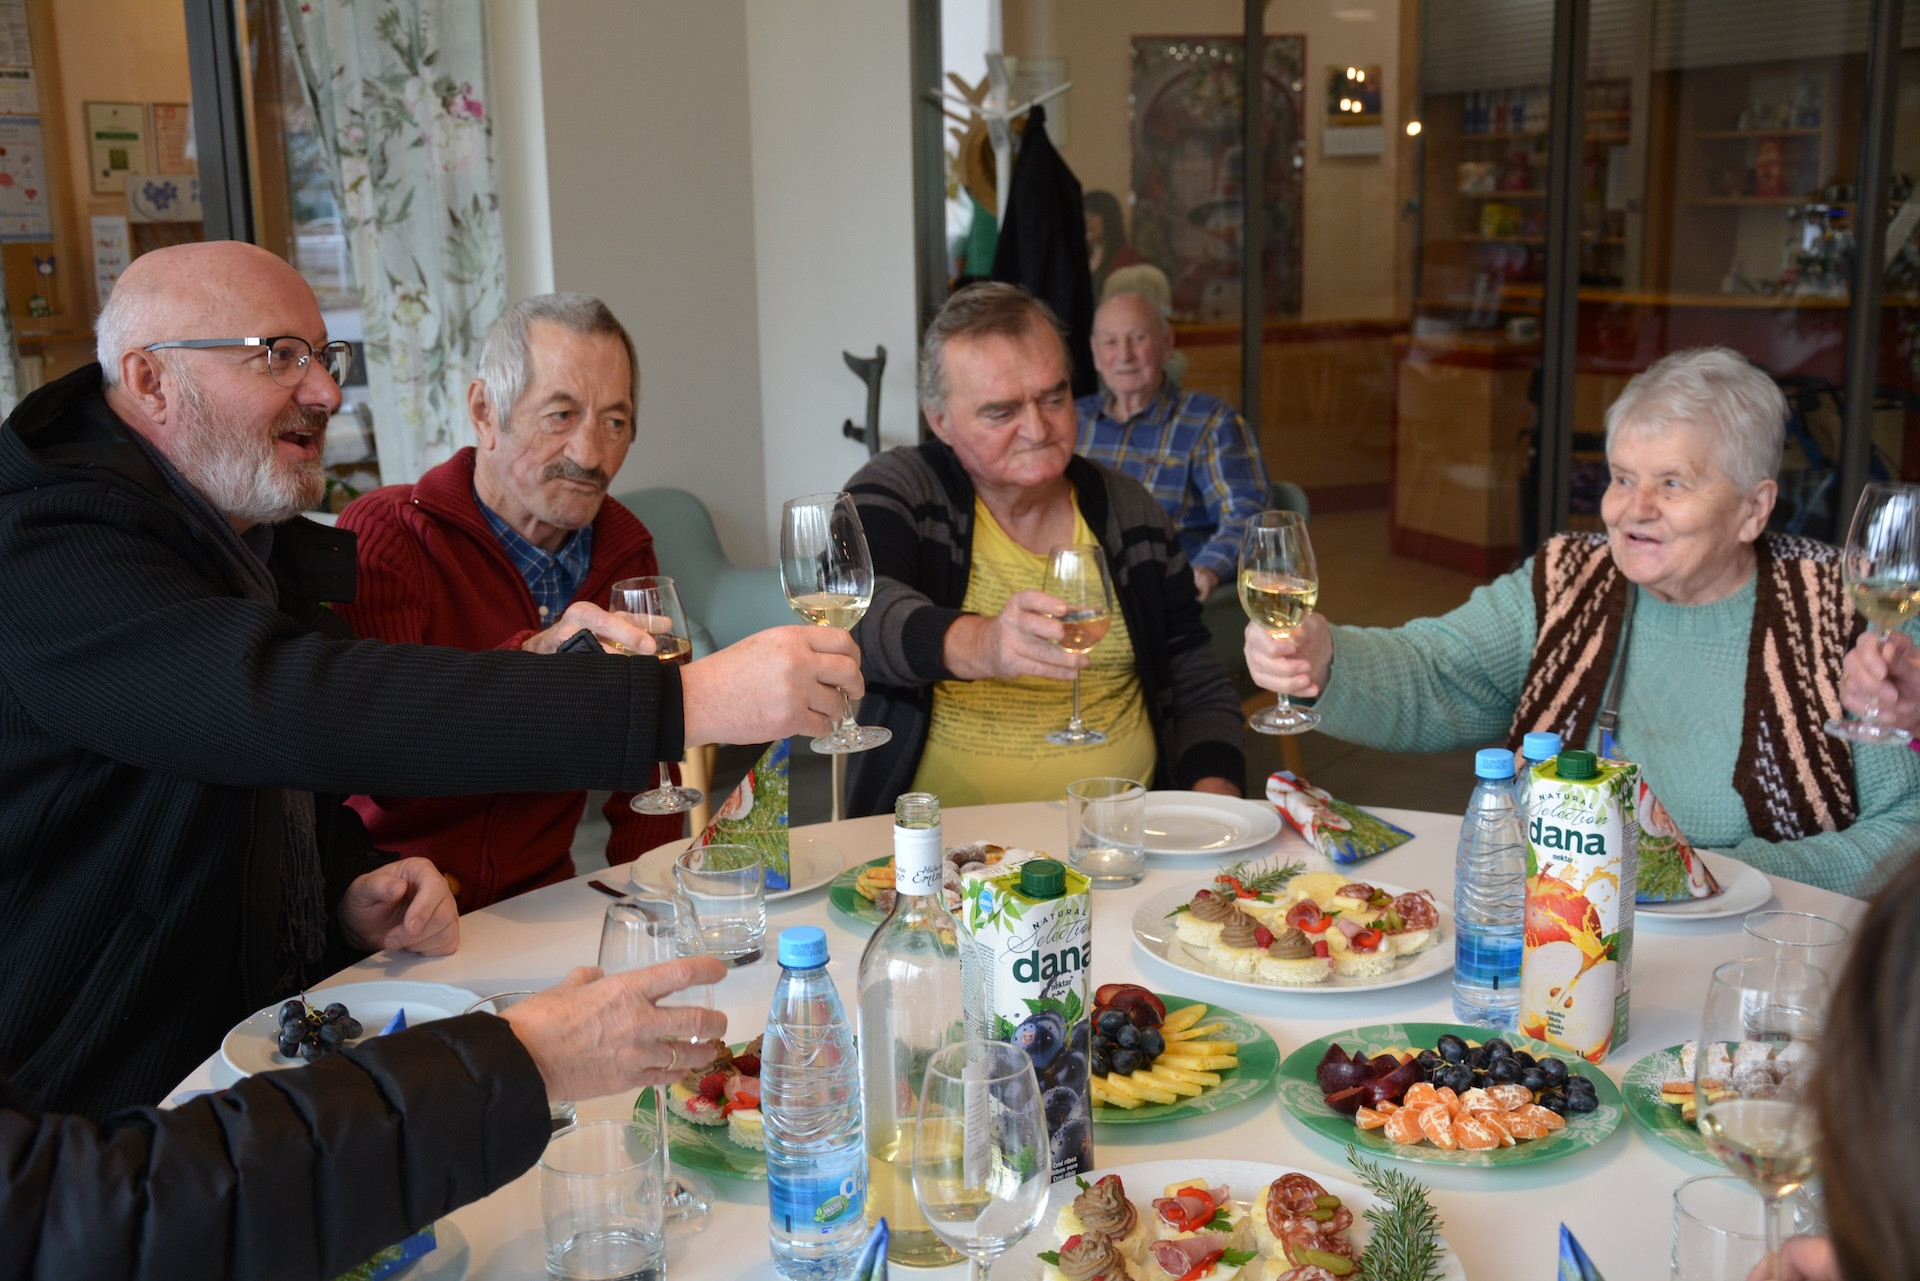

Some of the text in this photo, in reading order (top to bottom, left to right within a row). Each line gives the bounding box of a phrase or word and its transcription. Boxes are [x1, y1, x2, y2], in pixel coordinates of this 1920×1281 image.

[1529, 798, 1611, 825] Selection
[1539, 793, 1593, 809] NATURAL
[1530, 817, 1606, 855] dana
[1552, 854, 1573, 863] nektar
[1033, 909, 1086, 930] NATURAL
[1000, 918, 1089, 958] Selectio
[1051, 979, 1072, 991] nektar
